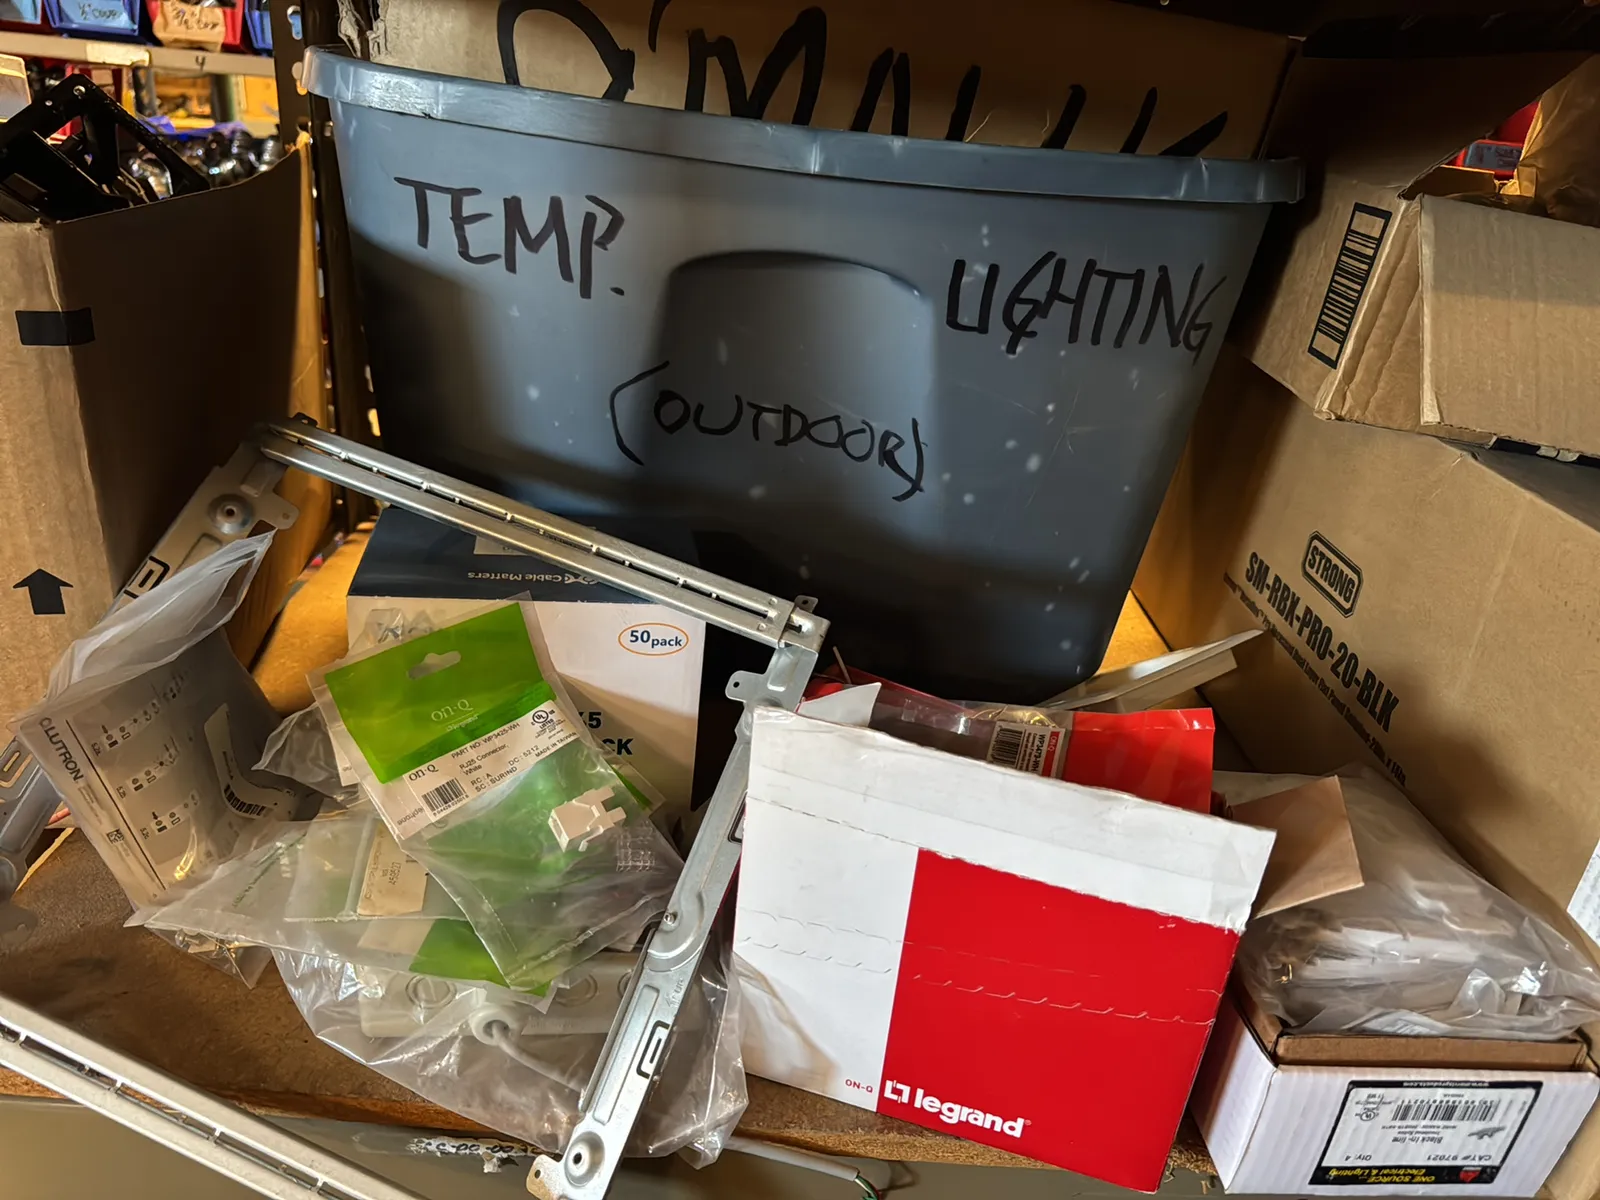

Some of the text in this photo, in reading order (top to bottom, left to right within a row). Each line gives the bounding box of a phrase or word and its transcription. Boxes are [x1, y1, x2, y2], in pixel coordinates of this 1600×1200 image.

[393, 176, 626, 299] TEMP.
[610, 360, 928, 502] (OUTDOOR)
[467, 571, 562, 582] Cable Matters
[1308, 545, 1356, 604] STRONG
[1245, 551, 1400, 733] SM-RBX-PRO-20-BLK
[44, 726, 84, 782] LUTRON
[451, 746, 469, 759] PART
[523, 745, 540, 757] 5212
[534, 746, 551, 758] MADE
[459, 758, 477, 769] RJ25
[462, 763, 482, 776] White
[489, 766, 518, 785] SURIND
[845, 1079, 873, 1093] ON-Q
[913, 1088, 1025, 1138] legrand
[1328, 1168, 1369, 1177] Lighting
[1380, 1168, 1426, 1176] Electrical
